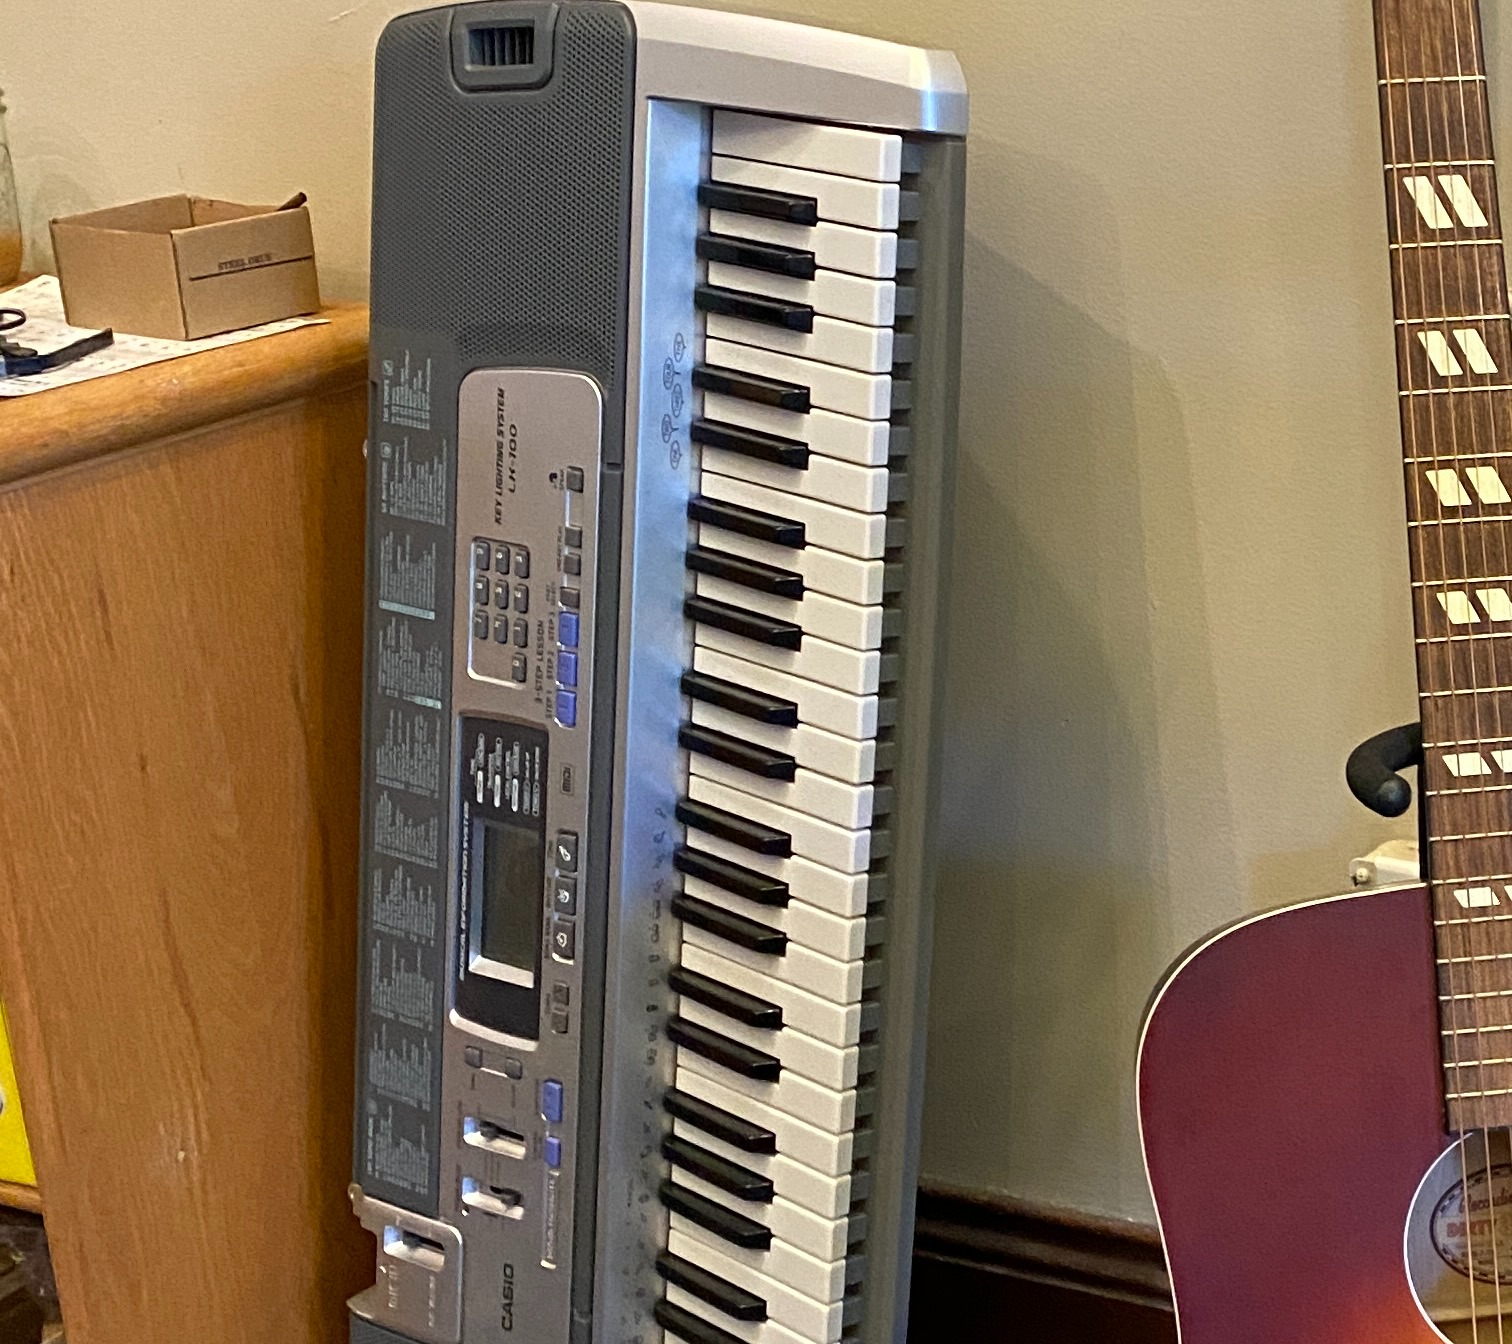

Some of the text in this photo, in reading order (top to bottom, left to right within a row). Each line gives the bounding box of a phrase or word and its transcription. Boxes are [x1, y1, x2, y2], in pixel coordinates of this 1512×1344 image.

[494, 387, 505, 525] KEY LIGHTING SYSTEM
[508, 423, 518, 493] LK-100
[535, 619, 544, 662] LESSON
[501, 1263, 515, 1332] CASIO
